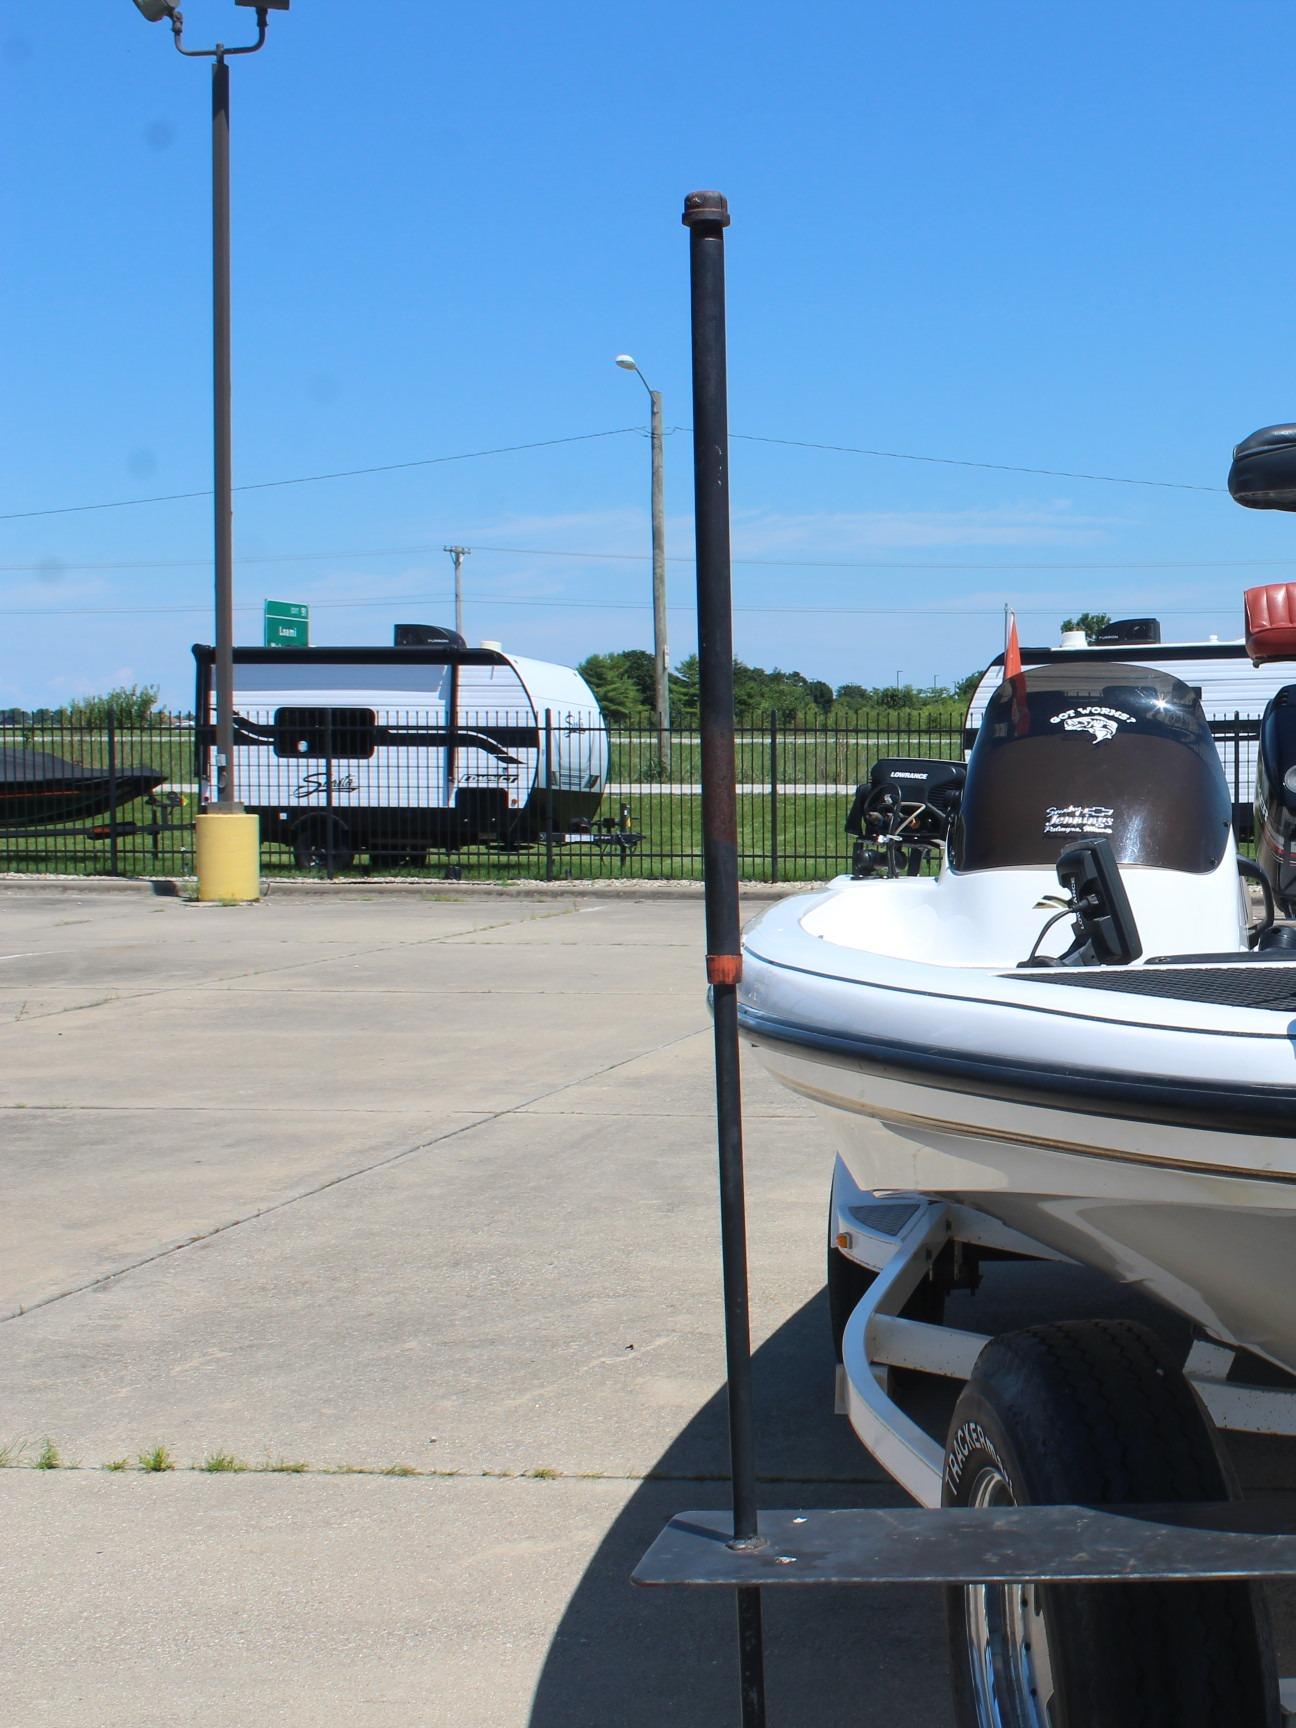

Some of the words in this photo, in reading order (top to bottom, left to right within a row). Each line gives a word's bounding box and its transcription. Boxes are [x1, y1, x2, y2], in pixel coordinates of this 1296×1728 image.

[1049, 709, 1072, 724] GOT
[1077, 706, 1137, 723] WORMS?
[890, 771, 929, 780] LOWRANCE
[1045, 814, 1114, 827] Jennings
